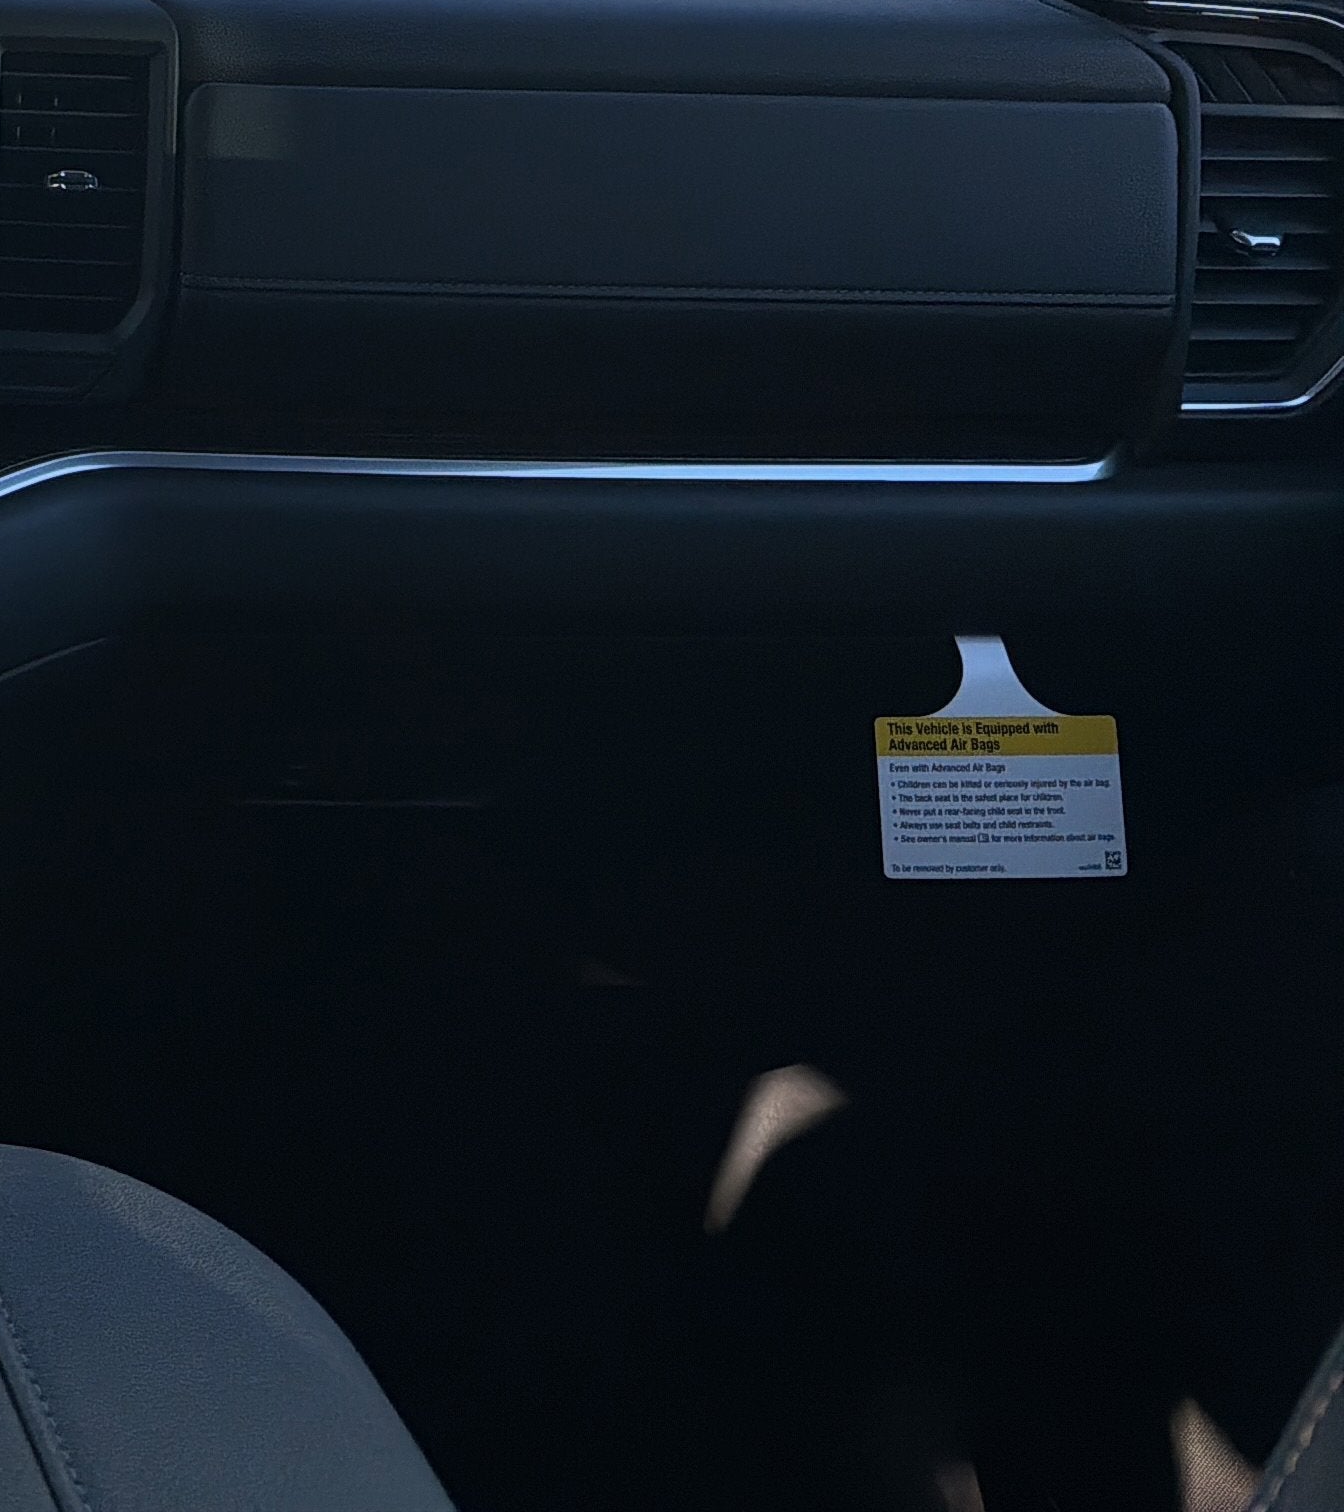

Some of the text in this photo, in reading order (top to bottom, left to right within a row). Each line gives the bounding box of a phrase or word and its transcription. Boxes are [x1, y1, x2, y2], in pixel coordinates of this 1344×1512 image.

[887, 721, 1059, 738] This Vehicle is Equipped with
[889, 737, 1001, 754] Advanced Air Bags
[889, 762, 1006, 775] Even with Advanced Air Bags
[897, 780, 931, 789] Children
[933, 781, 947, 789] can
[948, 780, 959, 789] be
[961, 780, 982, 789] killed
[994, 780, 1029, 791] seriously
[1031, 779, 1057, 790] injured
[1059, 779, 1068, 790] by
[1069, 778, 1082, 788] the
[1083, 779, 1093, 787] air
[892, 863, 901, 873] To
[902, 864, 912, 872] be
[913, 864, 945, 873] removed
[946, 864, 955, 875] by
[956, 864, 989, 872] customer
